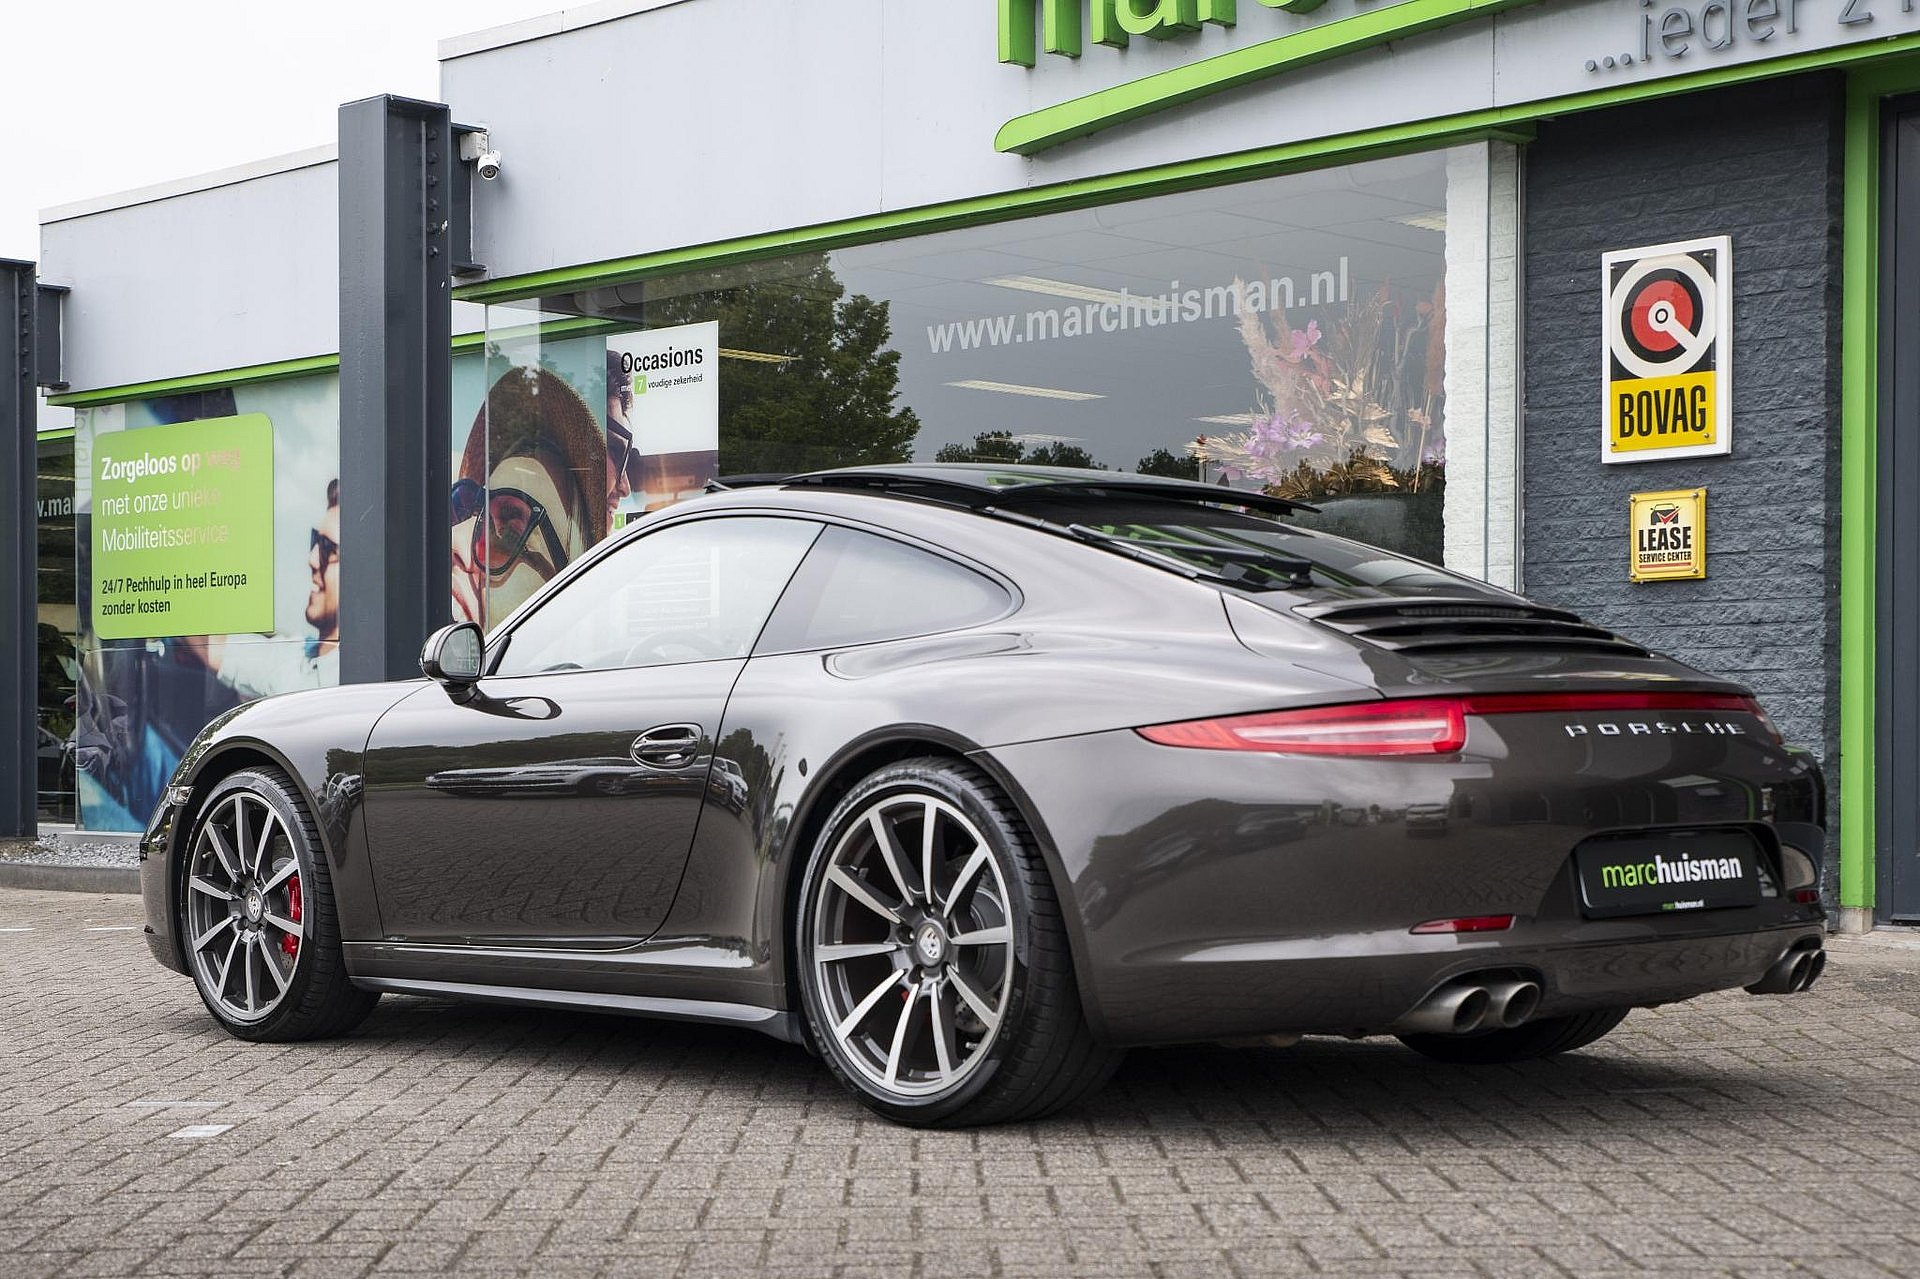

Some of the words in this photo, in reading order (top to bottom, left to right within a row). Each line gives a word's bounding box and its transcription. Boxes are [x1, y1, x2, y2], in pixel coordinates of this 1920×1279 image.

[927, 256, 1349, 353] www.marchuisman.nl
[621, 346, 703, 374] Occasions
[648, 378, 672, 389] voudige
[673, 373, 703, 386] zekerheid
[1619, 385, 1706, 438] BOVAG
[101, 452, 177, 483] Zorgeloos
[181, 452, 201, 476] op
[102, 493, 130, 516] met
[133, 492, 168, 514] onze
[102, 524, 229, 552] Mobiliteitsservice
[1638, 526, 1692, 552] LEASE
[1638, 552, 1666, 563] SERVICE
[1667, 551, 1692, 562] CENTER
[102, 579, 124, 594] 24/7
[126, 575, 171, 594] Pechhulp
[173, 575, 183, 589] in
[186, 573, 207, 588] heel
[210, 571, 247, 589] Europa
[102, 600, 135, 615] zonder
[138, 598, 171, 613] kosten
[1564, 722, 1746, 737] PORSCHE
[1602, 853, 1743, 888] marchuisman
